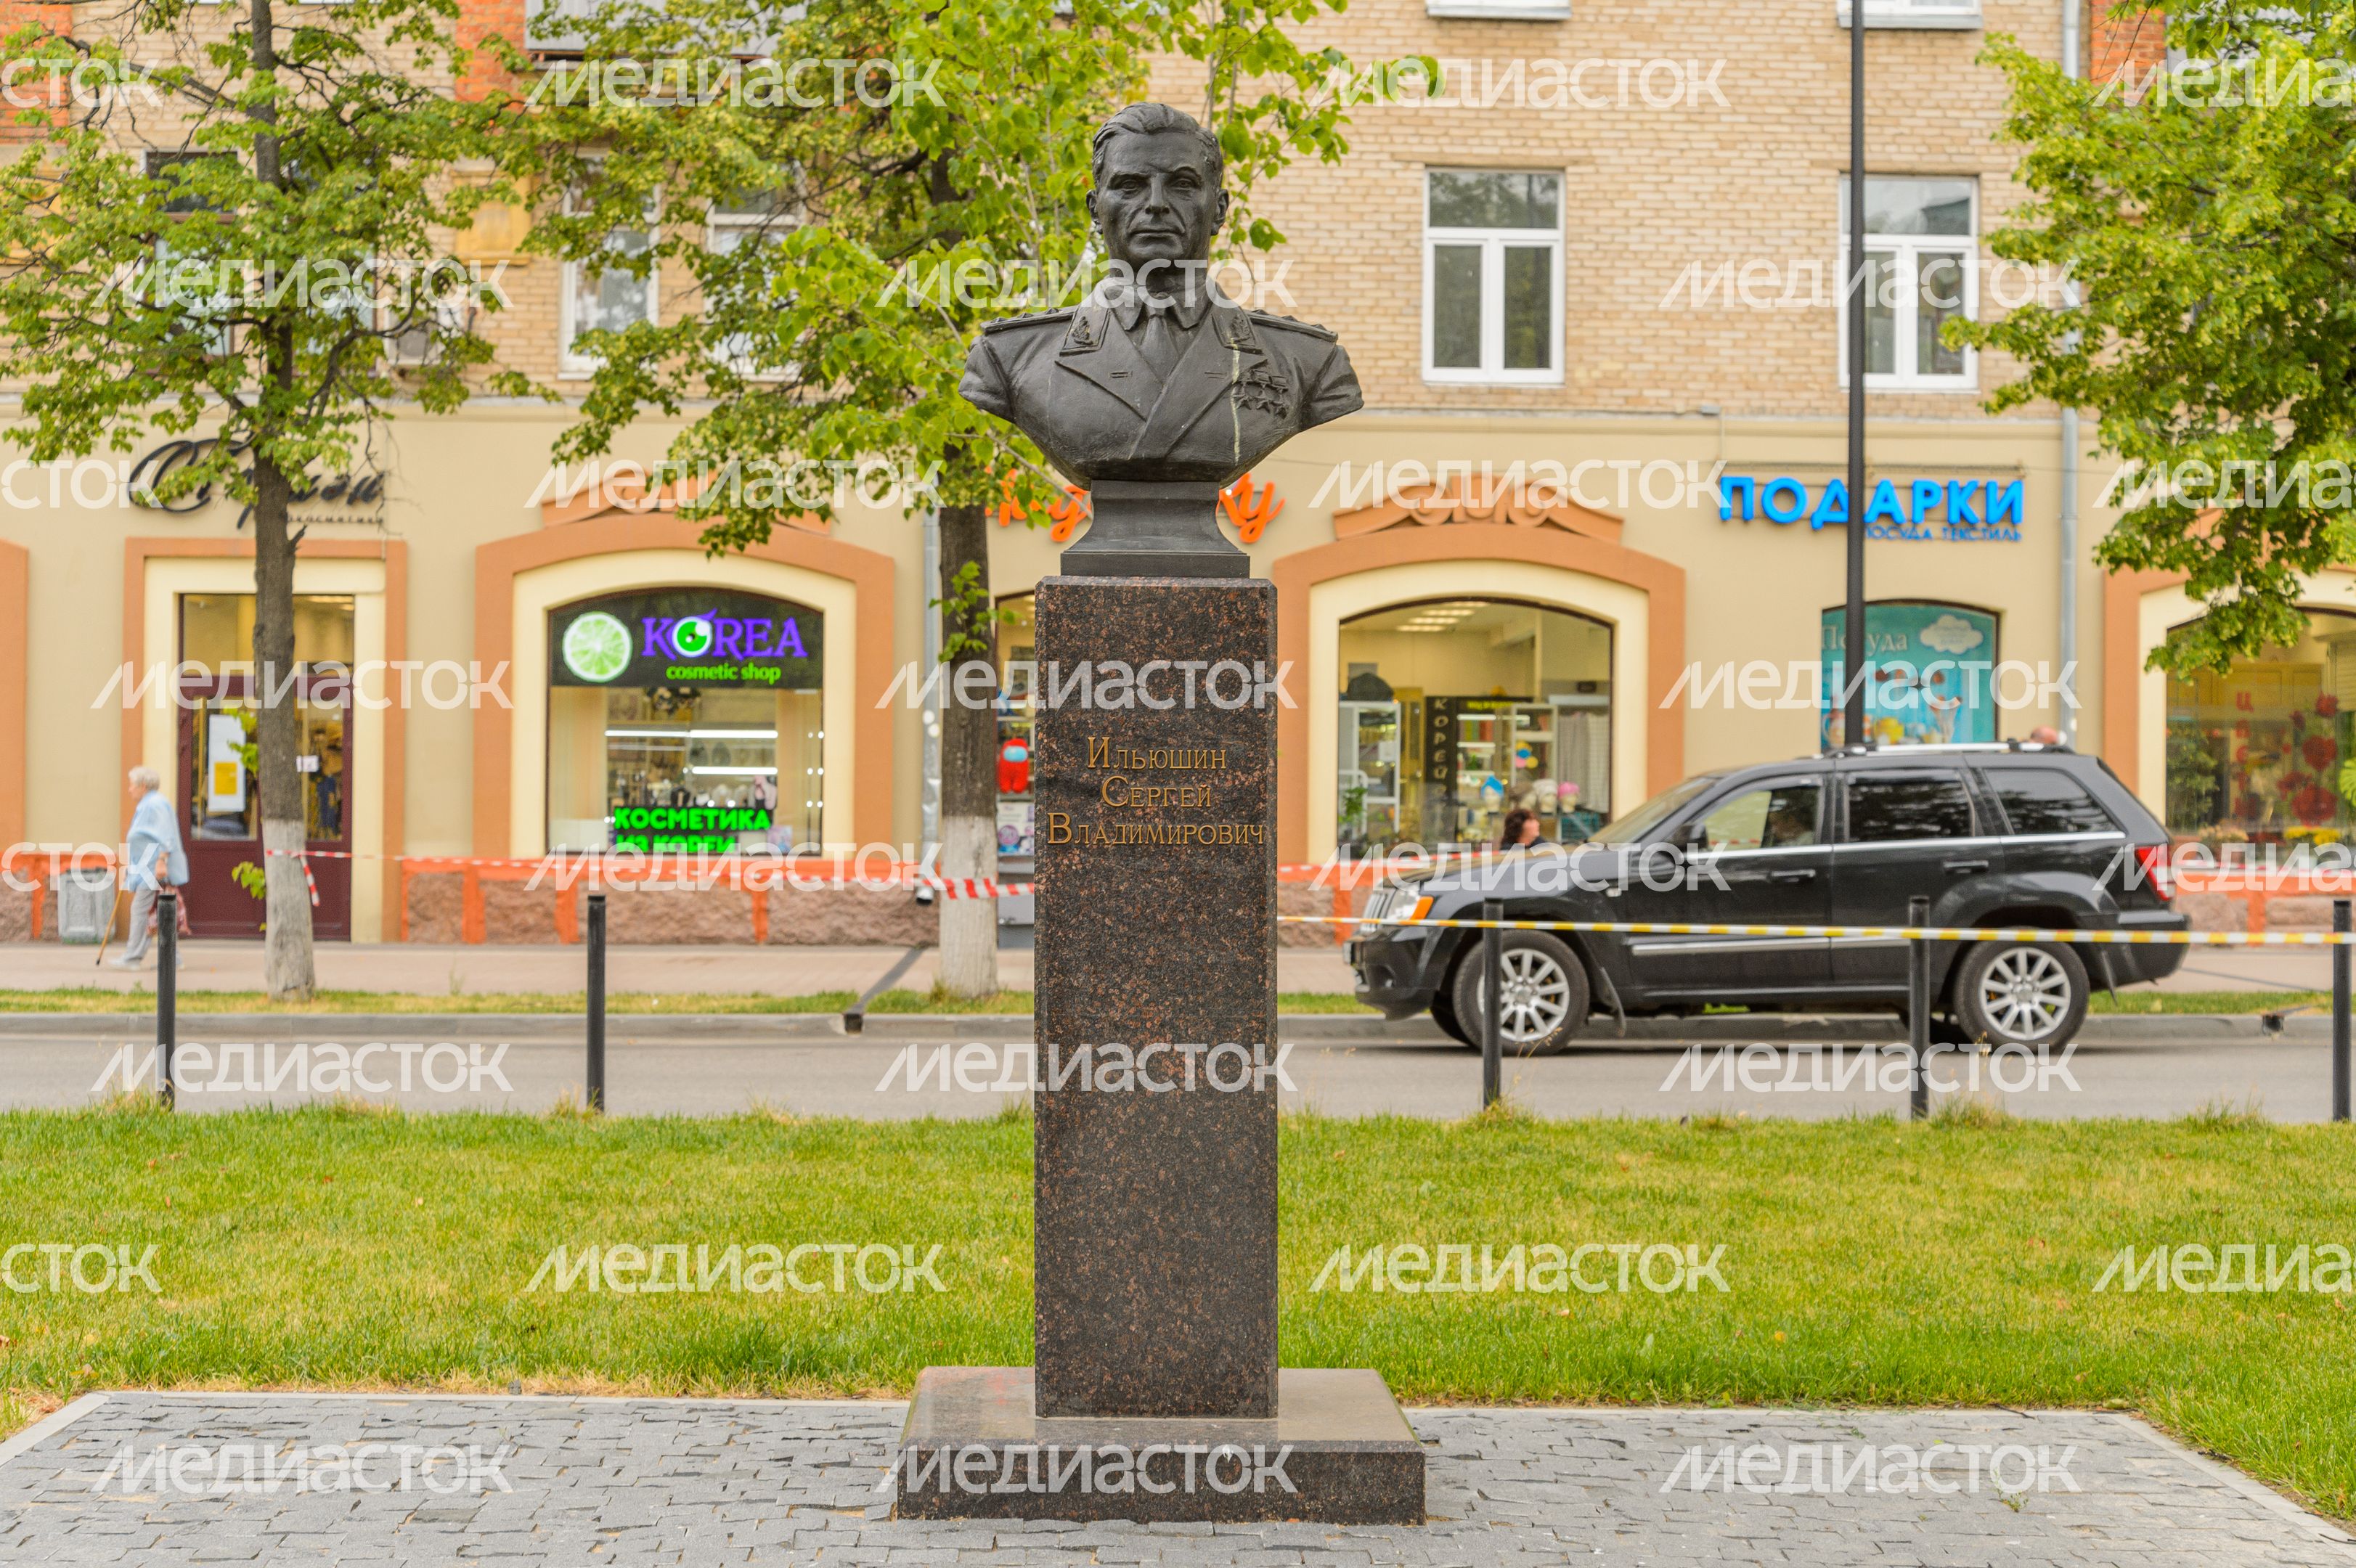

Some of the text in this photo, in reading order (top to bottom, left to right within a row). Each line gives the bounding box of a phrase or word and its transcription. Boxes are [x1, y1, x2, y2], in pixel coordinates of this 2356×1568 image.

[1719, 476, 2024, 531] ПОДАРКИ
[1941, 526, 2023, 542] ТЕКСТИЛЬ
[641, 608, 808, 661] KOREA
[666, 663, 782, 685] cosmetic shop
[614, 807, 771, 830] КОСМЕТИКА
